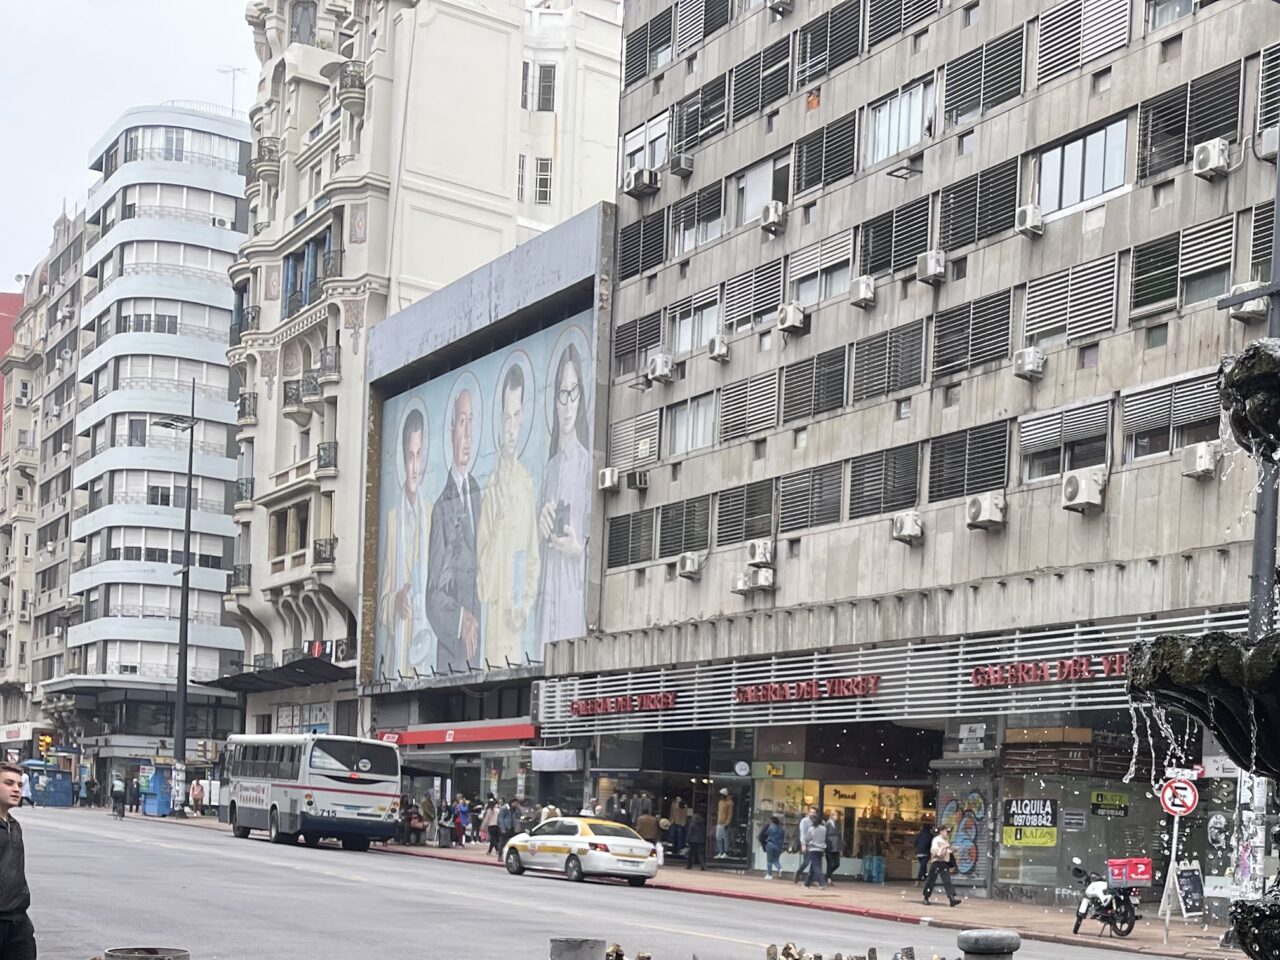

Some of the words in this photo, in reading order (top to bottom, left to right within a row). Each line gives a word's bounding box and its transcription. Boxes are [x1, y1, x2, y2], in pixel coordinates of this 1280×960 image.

[971, 660, 1050, 687] GALERIA
[1055, 656, 1096, 681] DEL
[735, 682, 791, 703] GALERIA
[794, 679, 822, 700] DEL
[825, 674, 880, 697] VIRREY
[320, 809, 337, 817] 715
[1010, 800, 1052, 814] ALQUILA
